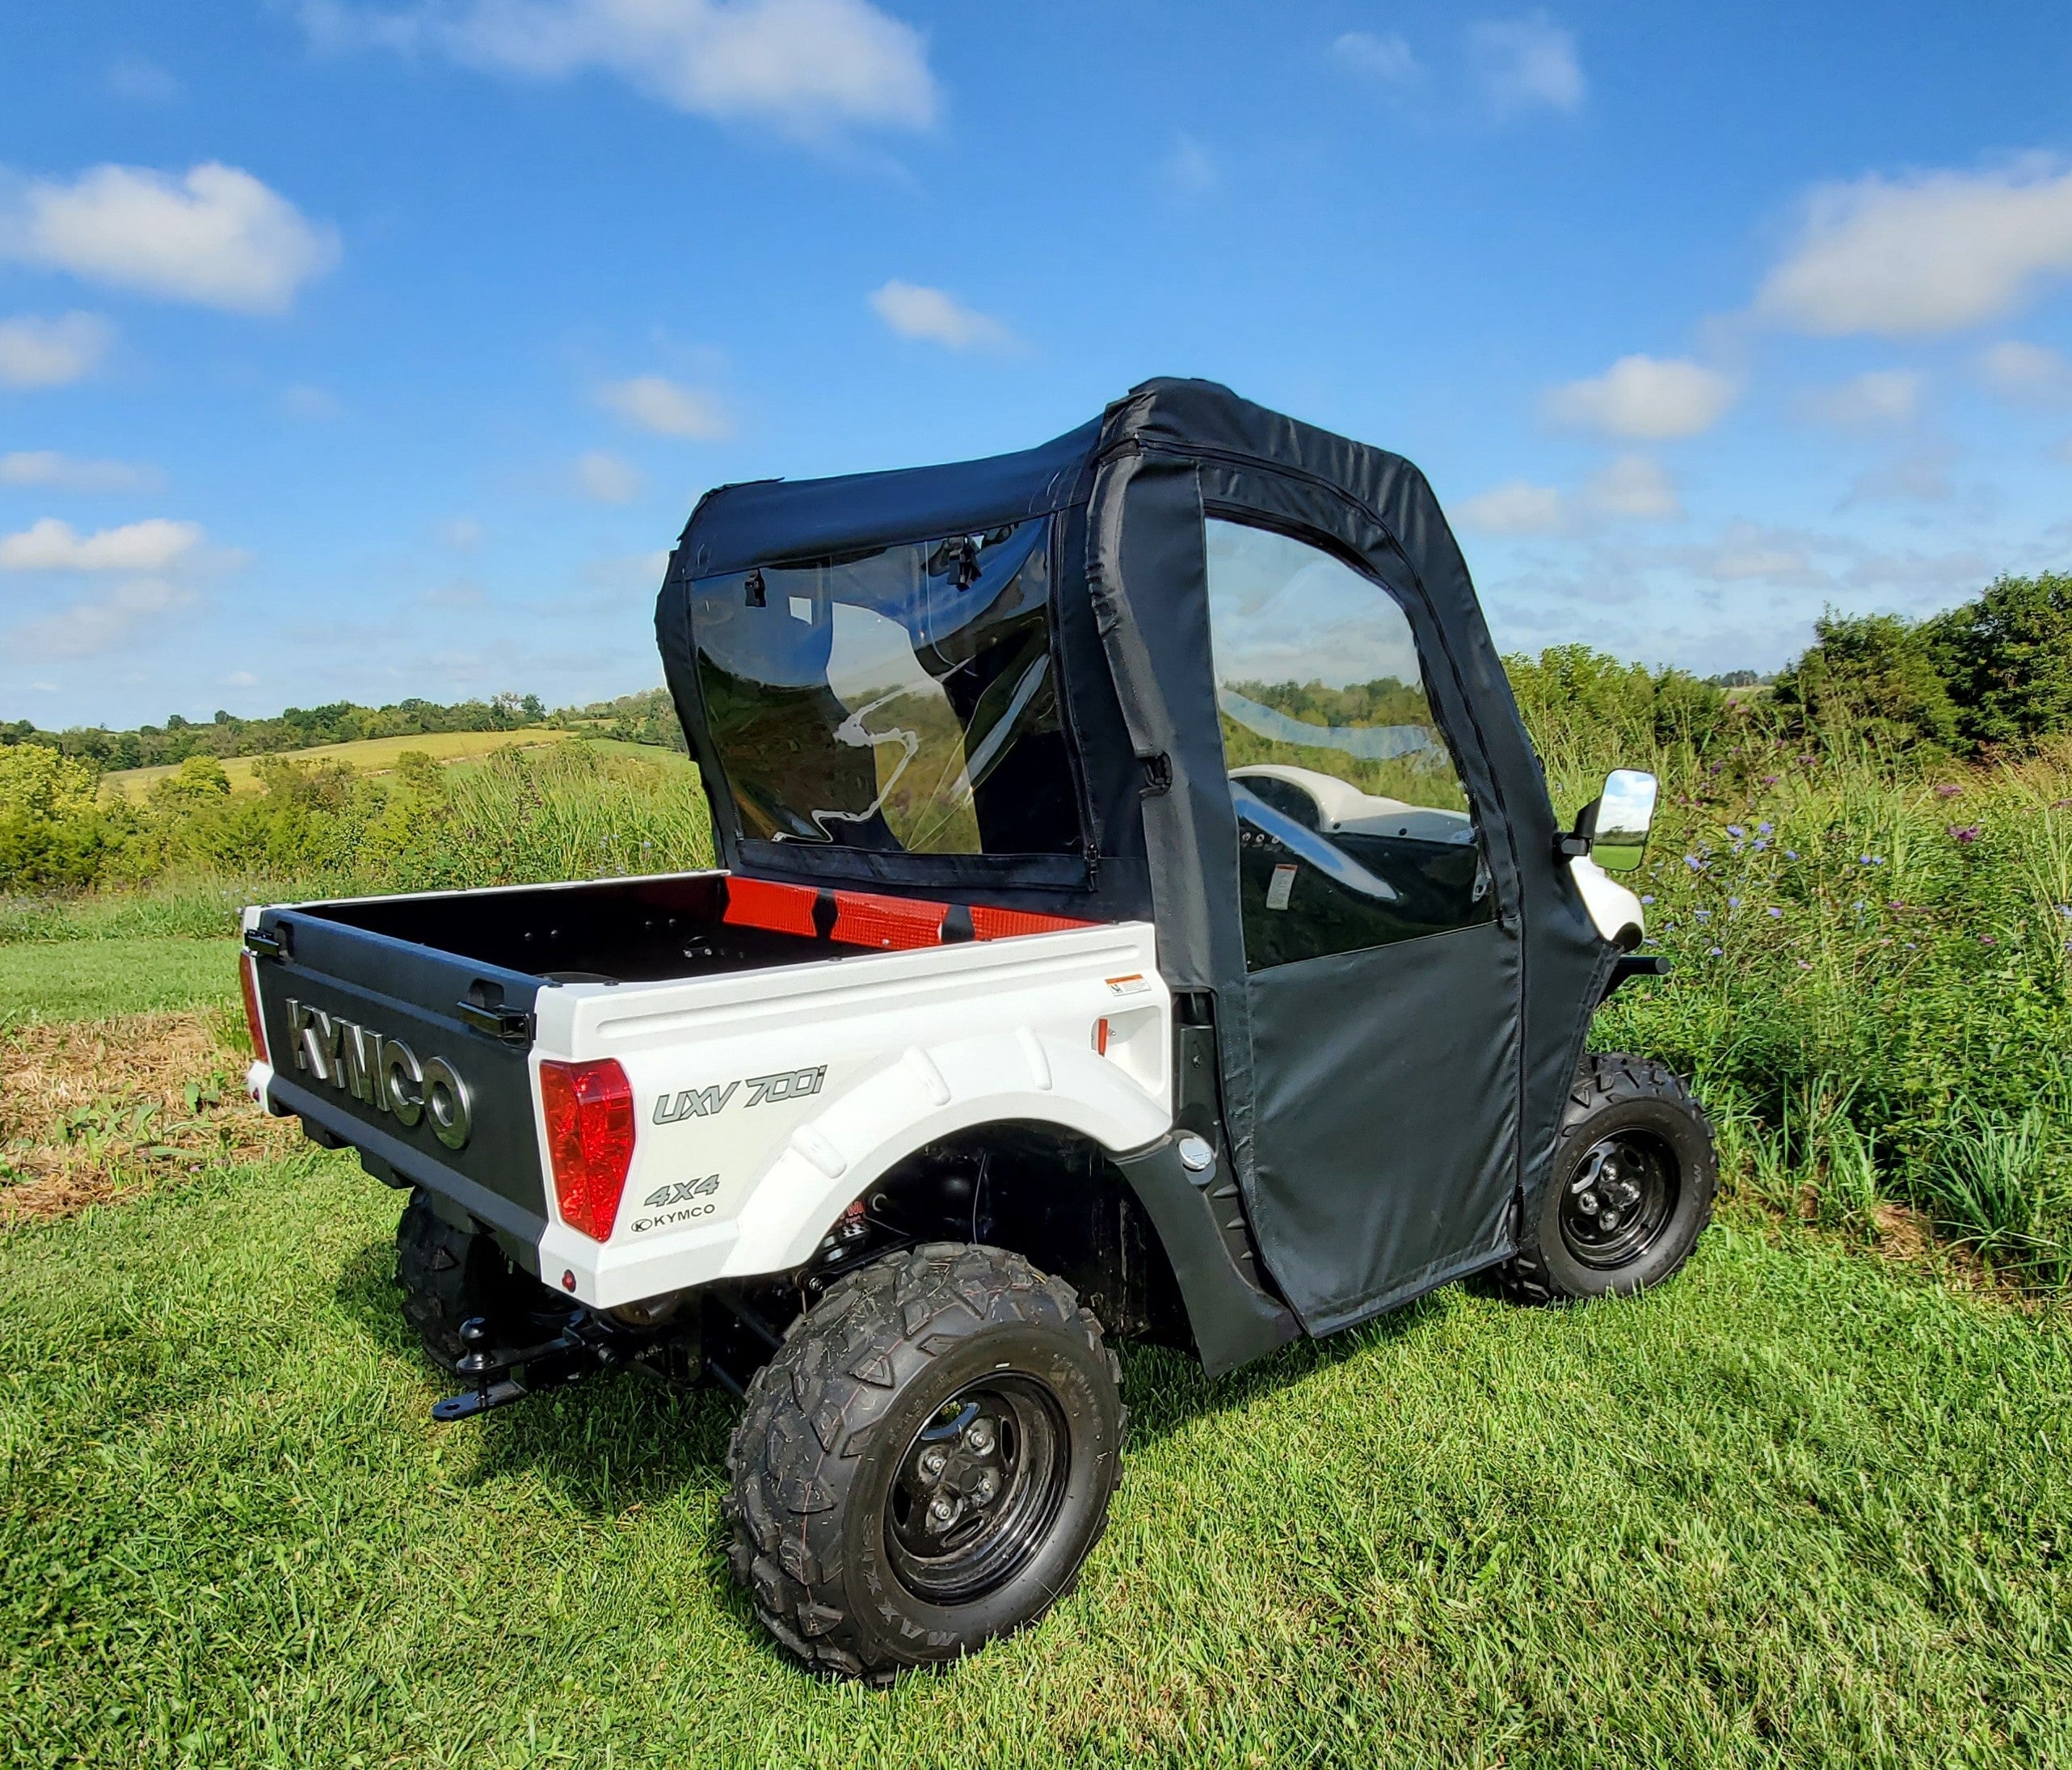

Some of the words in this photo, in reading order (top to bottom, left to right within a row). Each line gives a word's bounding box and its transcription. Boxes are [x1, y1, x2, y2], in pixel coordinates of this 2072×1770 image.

[285, 997, 471, 1149] KYMCO
[652, 1080, 742, 1125] UXV
[743, 1064, 828, 1108] 700i
[653, 1203, 716, 1228] KYMCO
[861, 1513, 959, 1647] MAXXIS
